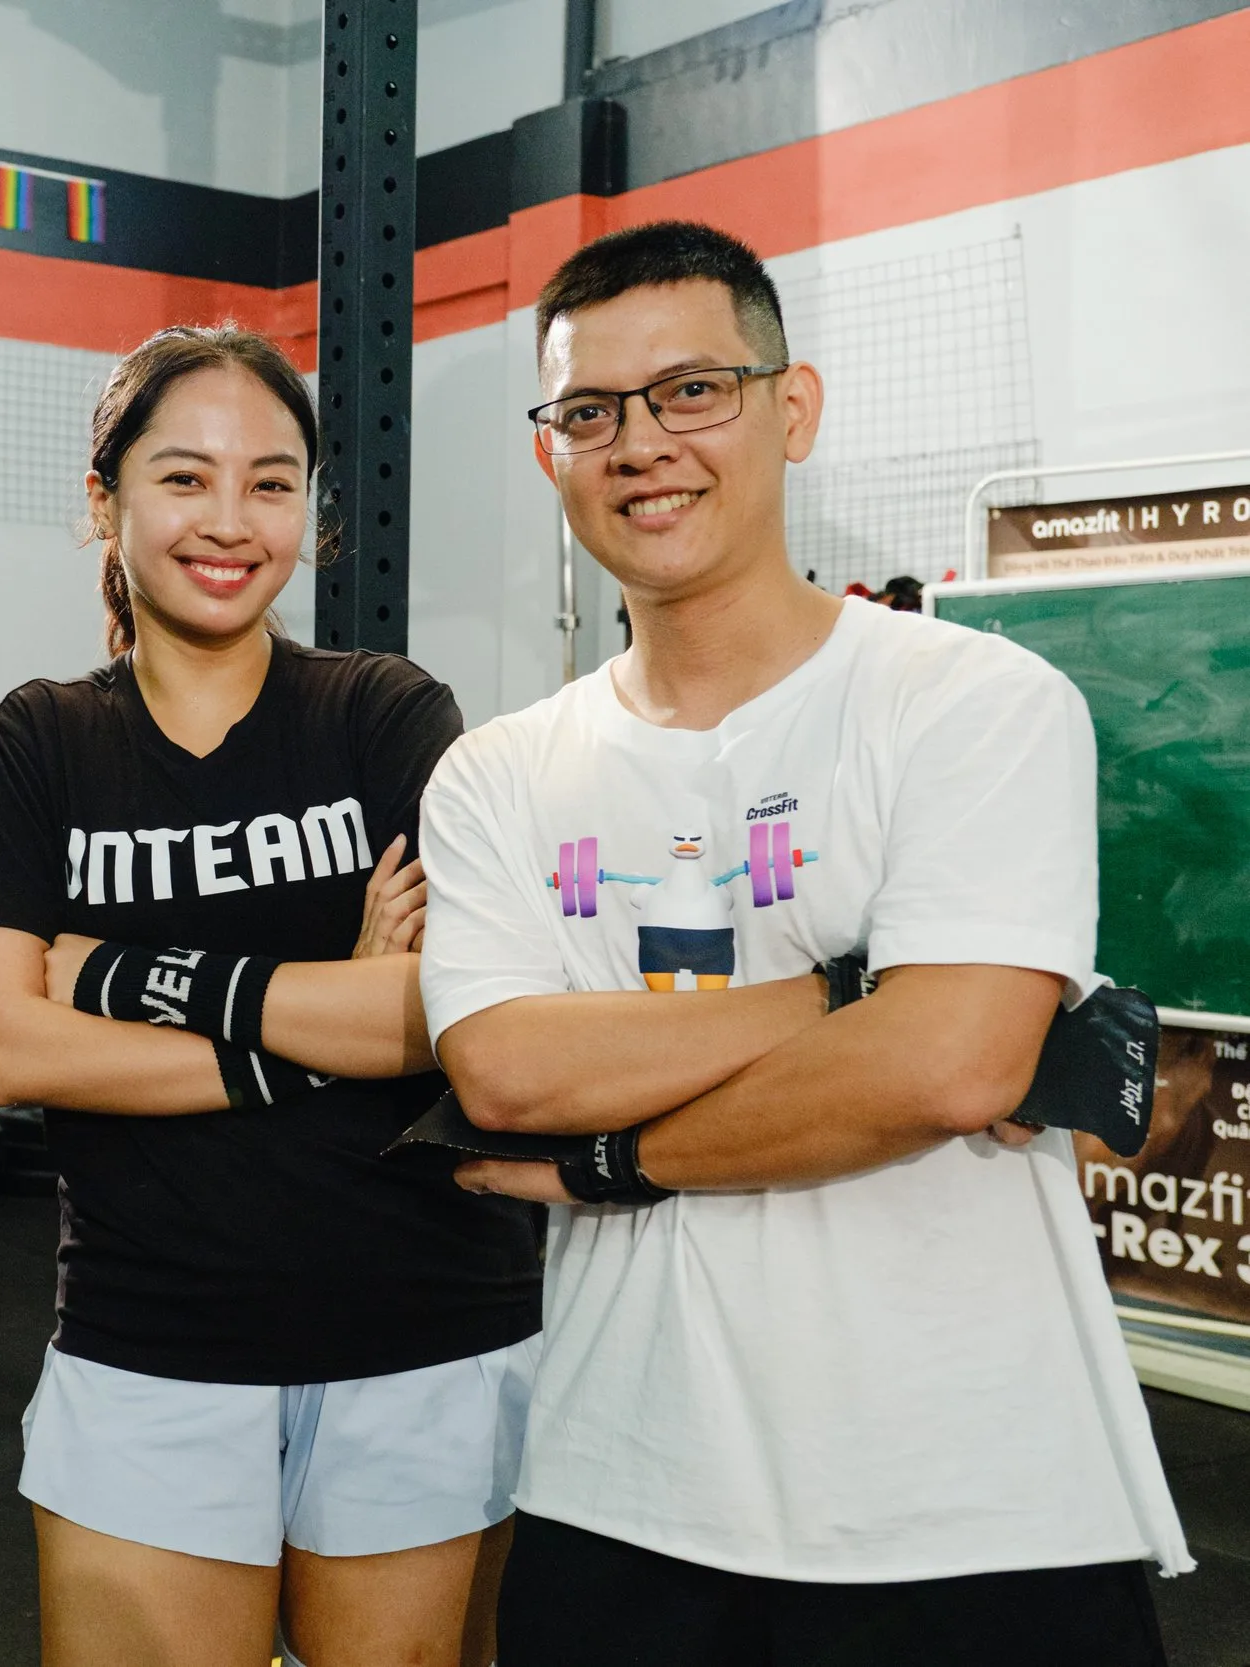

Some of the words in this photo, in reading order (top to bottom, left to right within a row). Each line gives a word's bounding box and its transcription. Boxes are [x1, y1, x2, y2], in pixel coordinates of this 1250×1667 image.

[1032, 508, 1120, 539] amazfit
[1141, 497, 1250, 530] HYRO
[746, 798, 799, 821] CrossFit
[140, 947, 206, 1025] VEL
[1084, 1160, 1250, 1226] mazfi
[1092, 1209, 1223, 1279] -Rex
